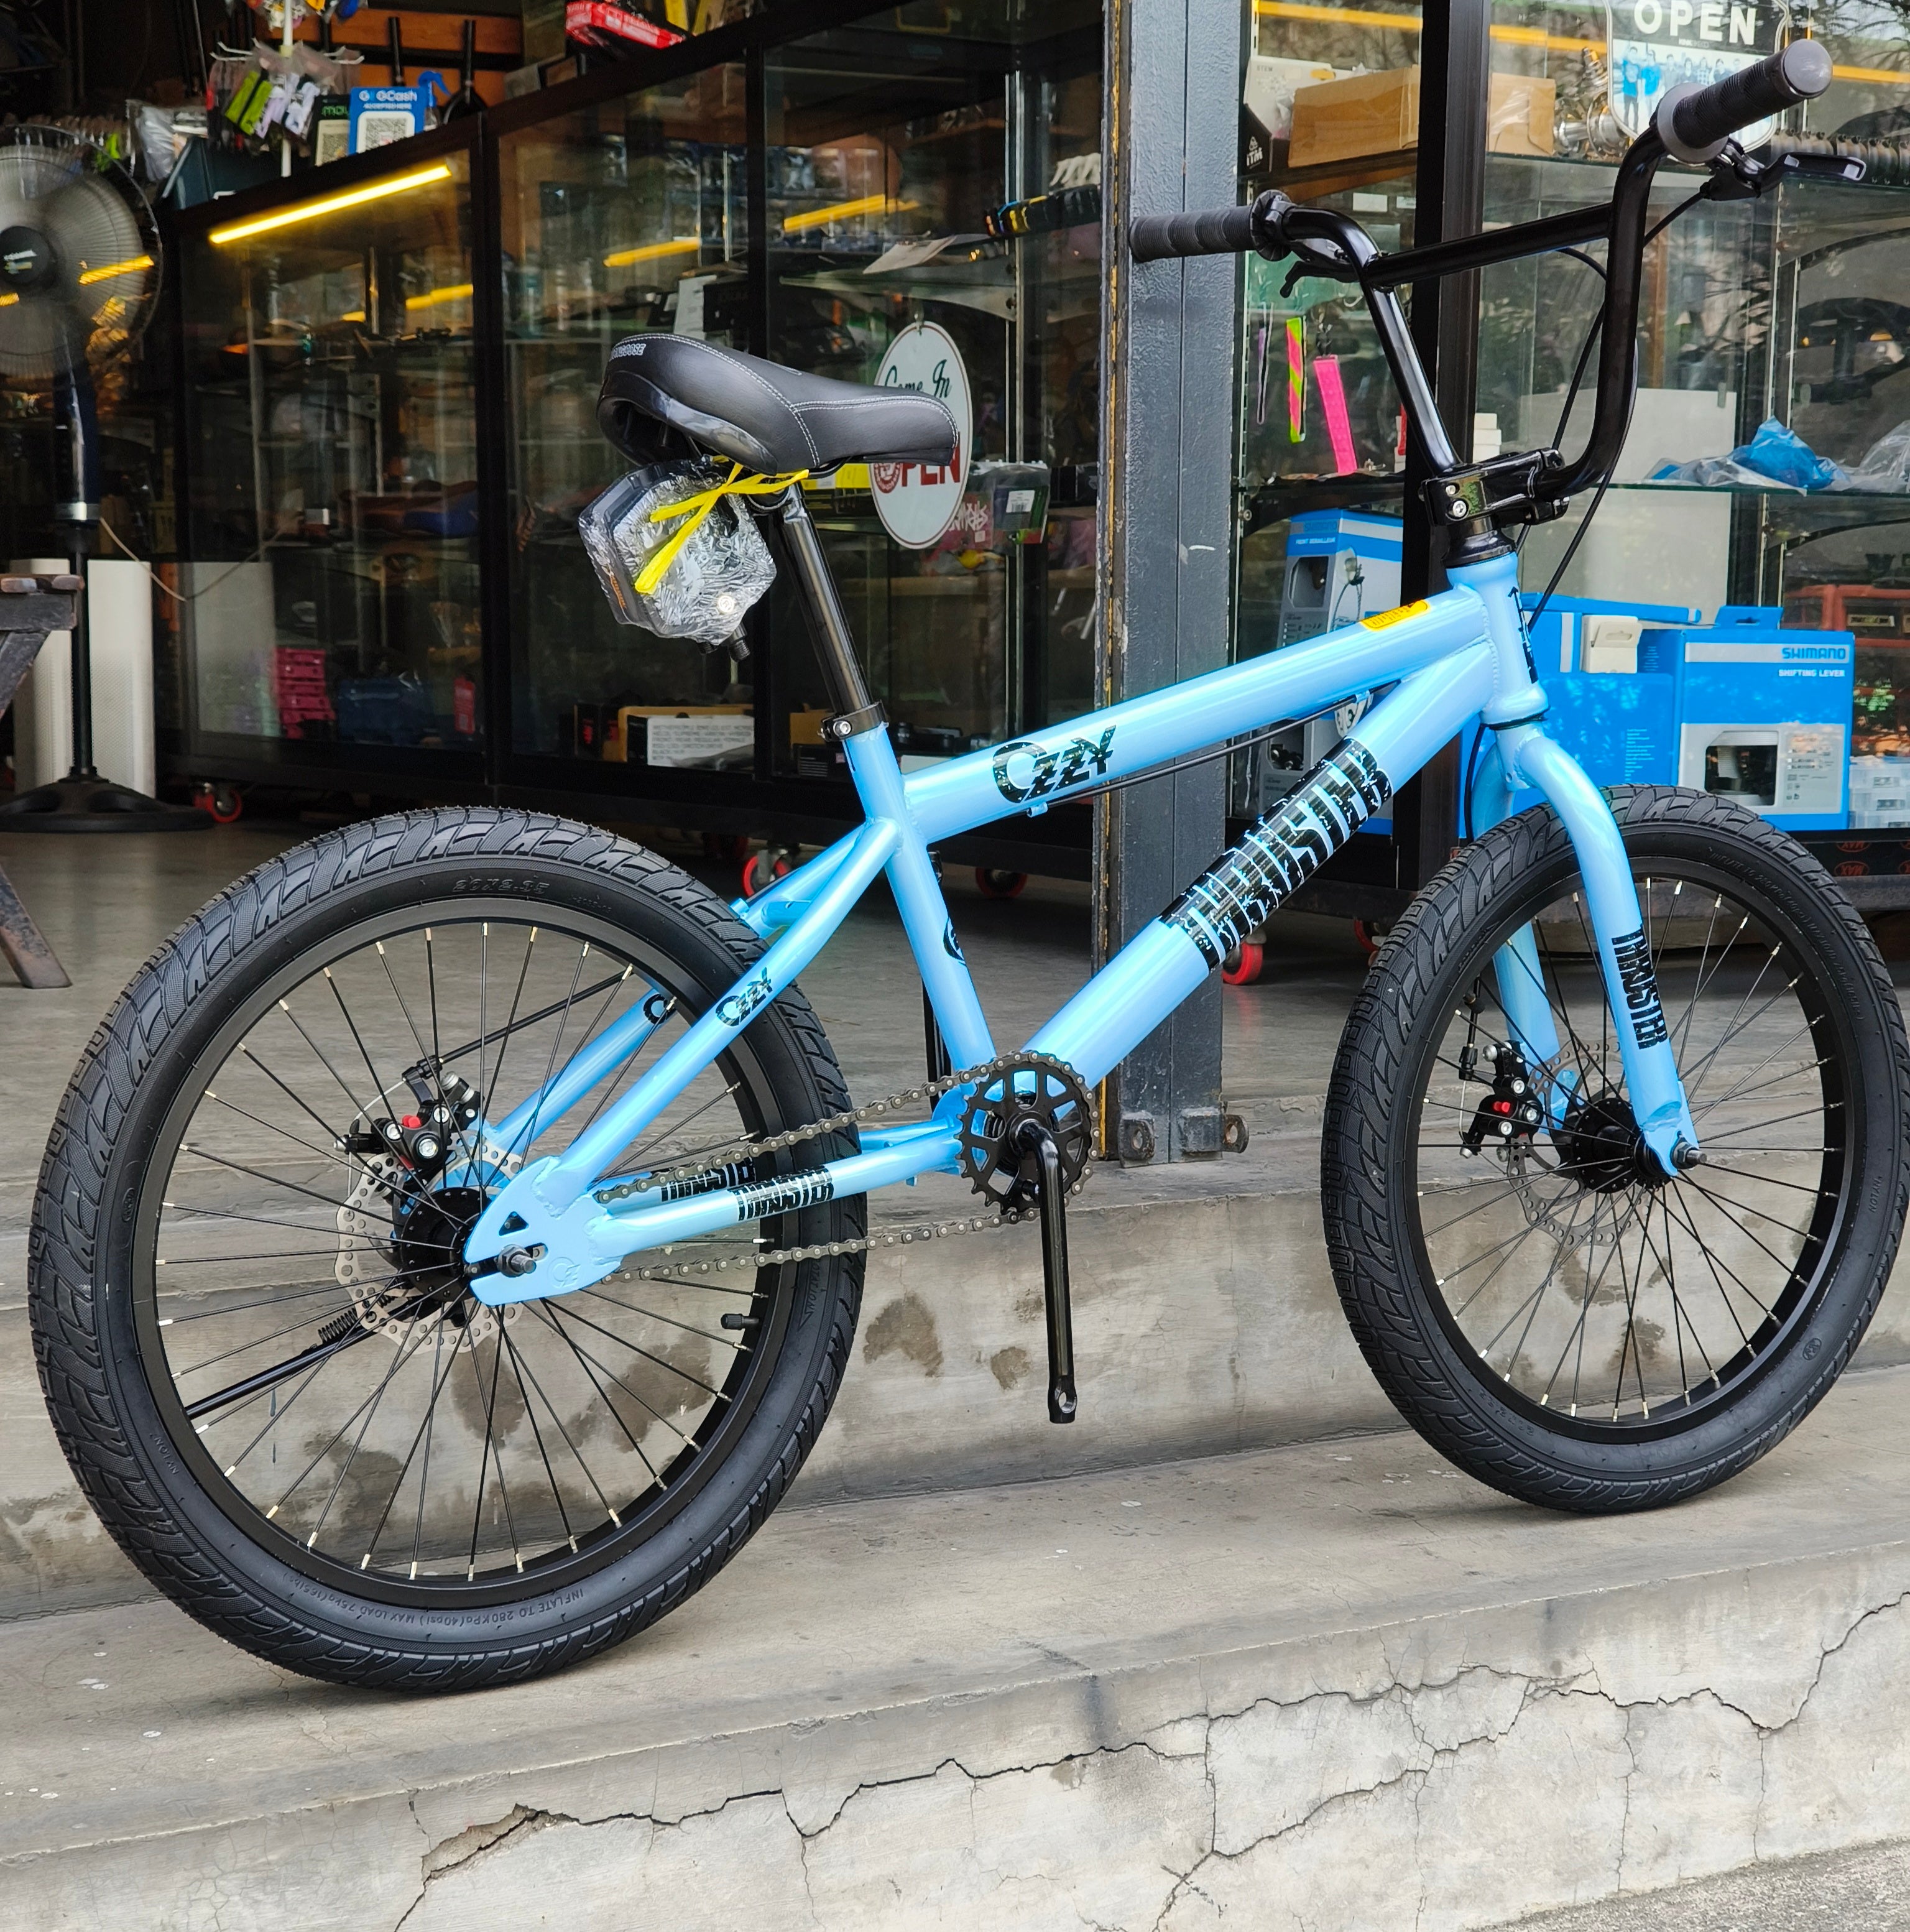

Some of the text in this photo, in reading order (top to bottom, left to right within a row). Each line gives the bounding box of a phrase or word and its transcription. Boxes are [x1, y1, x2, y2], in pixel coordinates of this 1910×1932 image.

[1634, 0, 1756, 45] OPEN
[376, 90, 417, 102] GCash
[1782, 647, 1846, 660] SHIMANO
[538, 1588, 583, 1614] INFLATE
[359, 1604, 389, 1620] LOAD
[390, 1613, 415, 1624] MAX
[519, 1606, 536, 1618] TO
